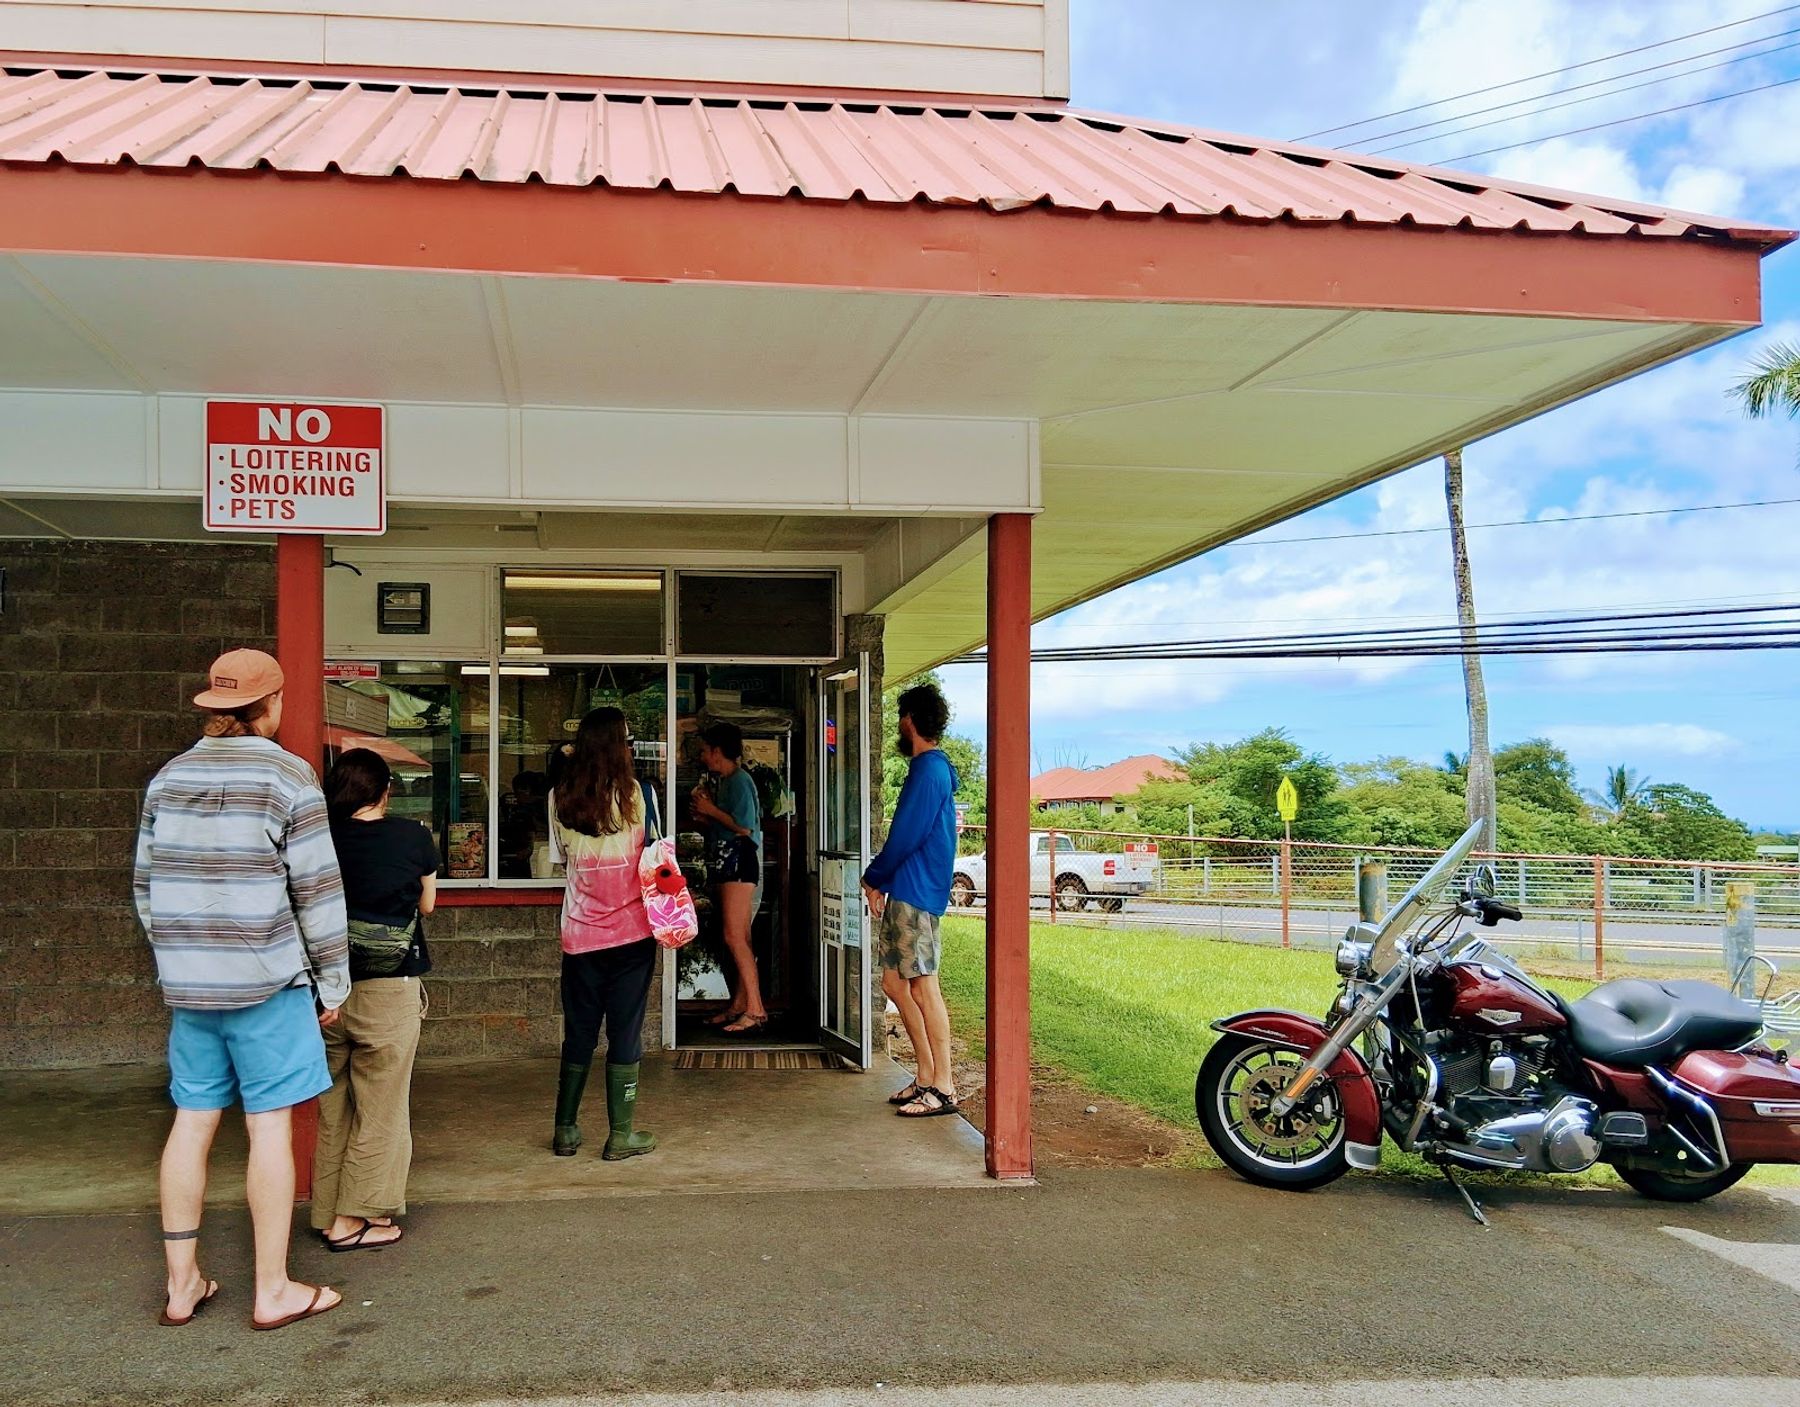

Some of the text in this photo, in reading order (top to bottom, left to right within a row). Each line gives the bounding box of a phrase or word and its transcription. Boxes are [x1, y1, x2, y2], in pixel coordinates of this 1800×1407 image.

[258, 407, 332, 443] NO
[230, 449, 371, 472] LOITERING
[230, 473, 355, 497] SMOKING
[230, 498, 296, 520] PETS
